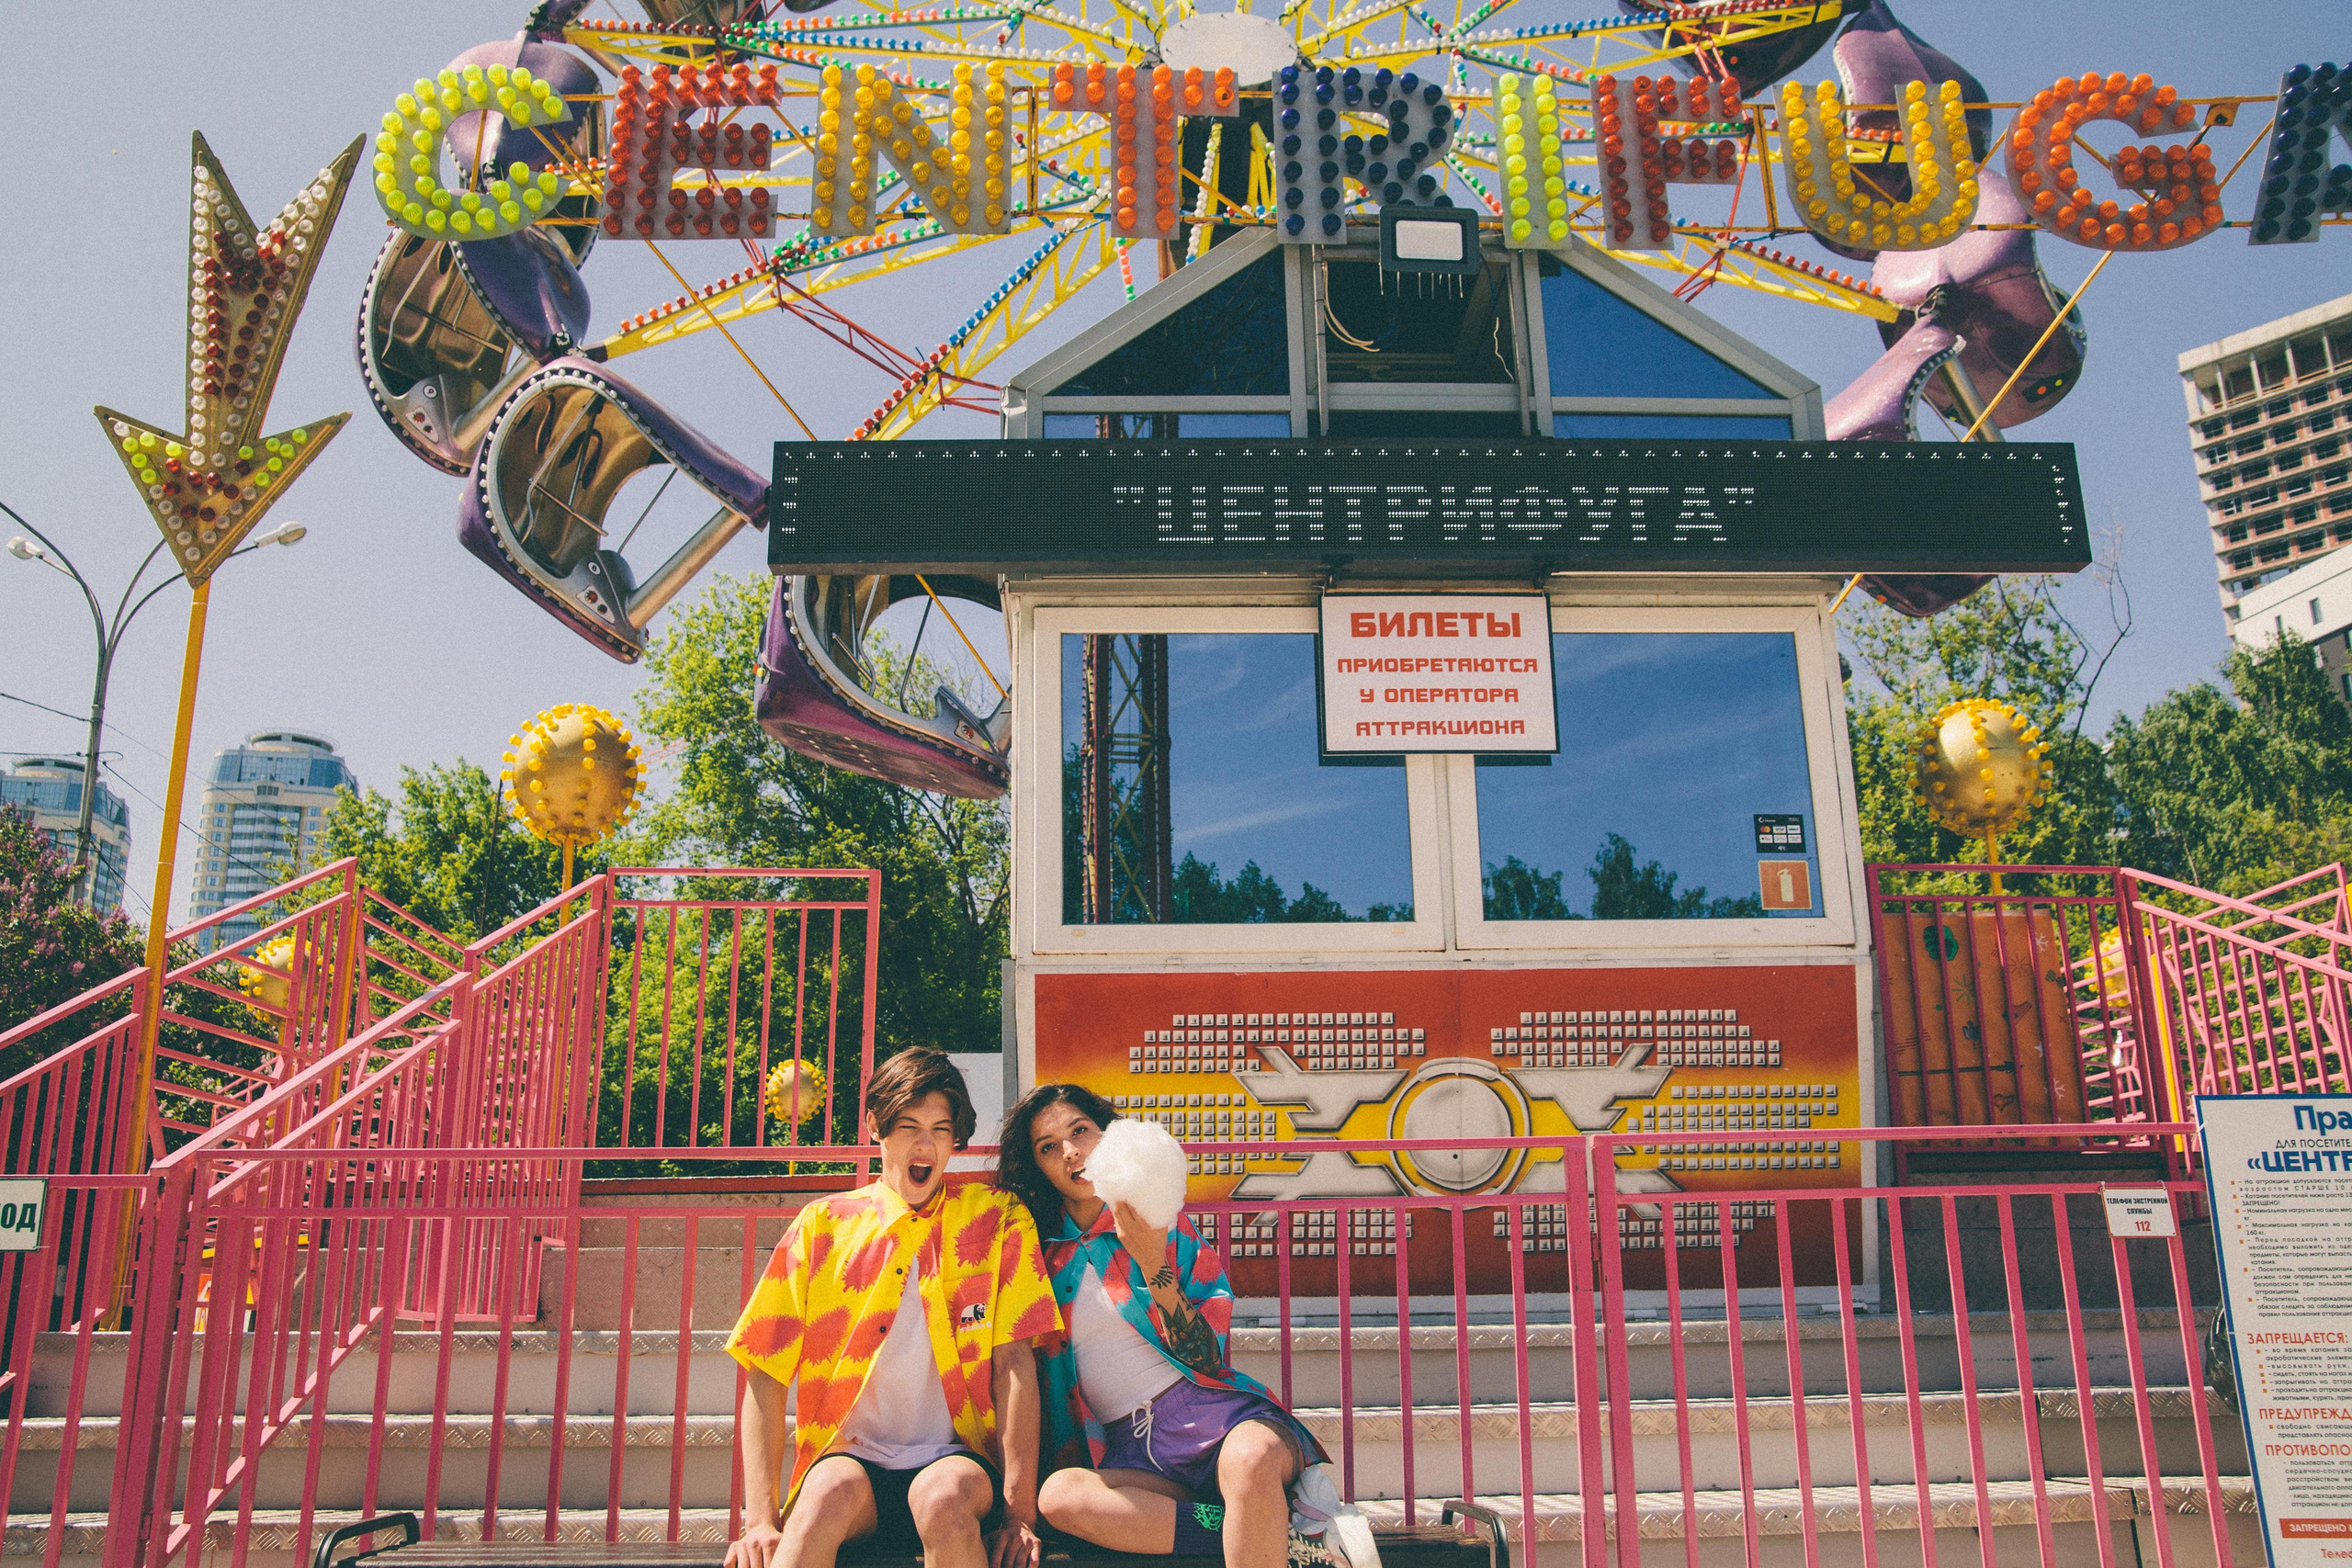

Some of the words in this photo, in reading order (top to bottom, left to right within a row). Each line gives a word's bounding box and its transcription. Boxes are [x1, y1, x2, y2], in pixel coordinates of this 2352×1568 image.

[1351, 612, 1521, 637] БИЛЕТЫ
[1338, 658, 1538, 673] ПРИОБРЕТАЮТСЯ
[1360, 689, 1374, 703] У
[1385, 689, 1519, 703] ОПЕРАТОРА
[1356, 720, 1525, 736] АТТРАКЦИОНА
[2293, 1105, 2352, 1136] Пра
[2275, 1139, 2297, 1148] ДЛЯ
[2300, 1139, 2351, 1148] ПОСЕТИТЕ
[0, 1202, 37, 1232] ОД
[2134, 1221, 2152, 1232] 112
[2247, 1332, 2348, 1345] ЗАПРЕЩАЕТСЯ:
[2259, 1407, 2352, 1421] ПРЕДУПРЕЖД
[2266, 1444, 2352, 1456] ПРОТИВОПО
[2290, 1524, 2346, 1533] ЗАПРЕЩЕНО
